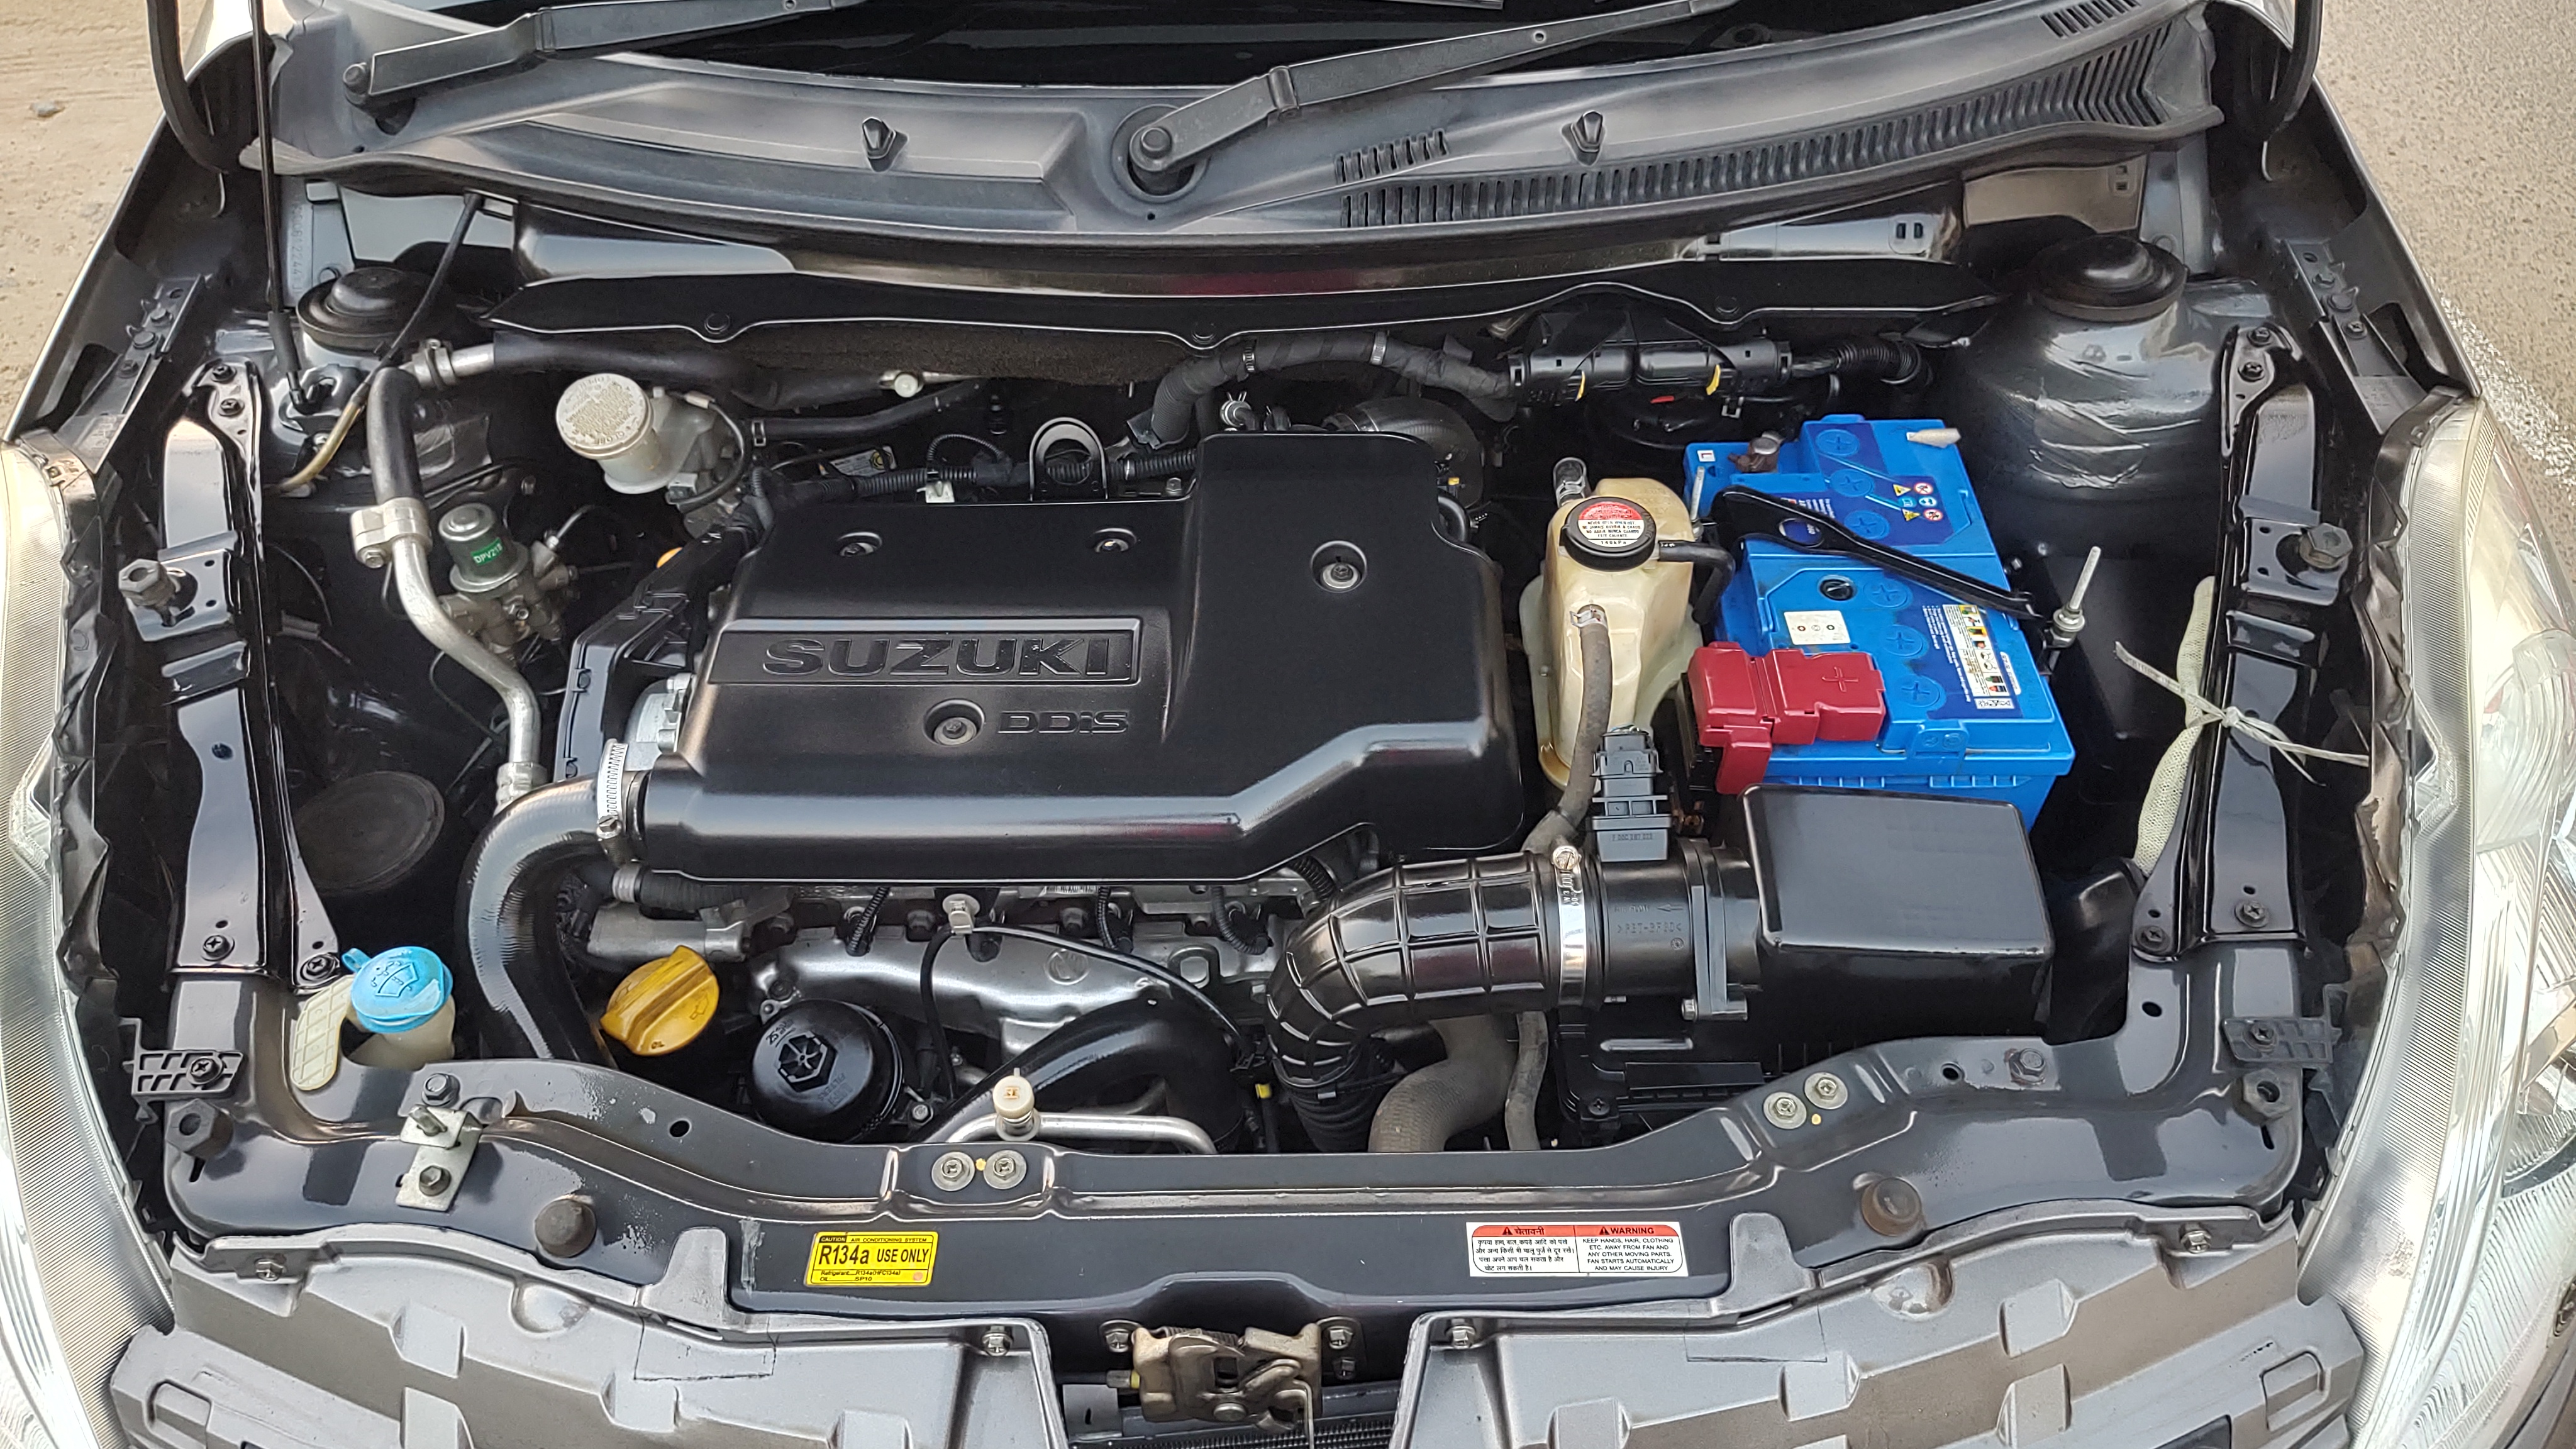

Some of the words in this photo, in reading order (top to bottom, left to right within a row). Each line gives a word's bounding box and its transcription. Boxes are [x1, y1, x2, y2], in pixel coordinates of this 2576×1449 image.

[762, 638, 1109, 677] SUZUKI
[1514, 1226, 1545, 1235] चेतावनी
[819, 1245, 870, 1265] R134a
[877, 1249, 899, 1262] USE
[901, 1248, 930, 1262] ONLY
